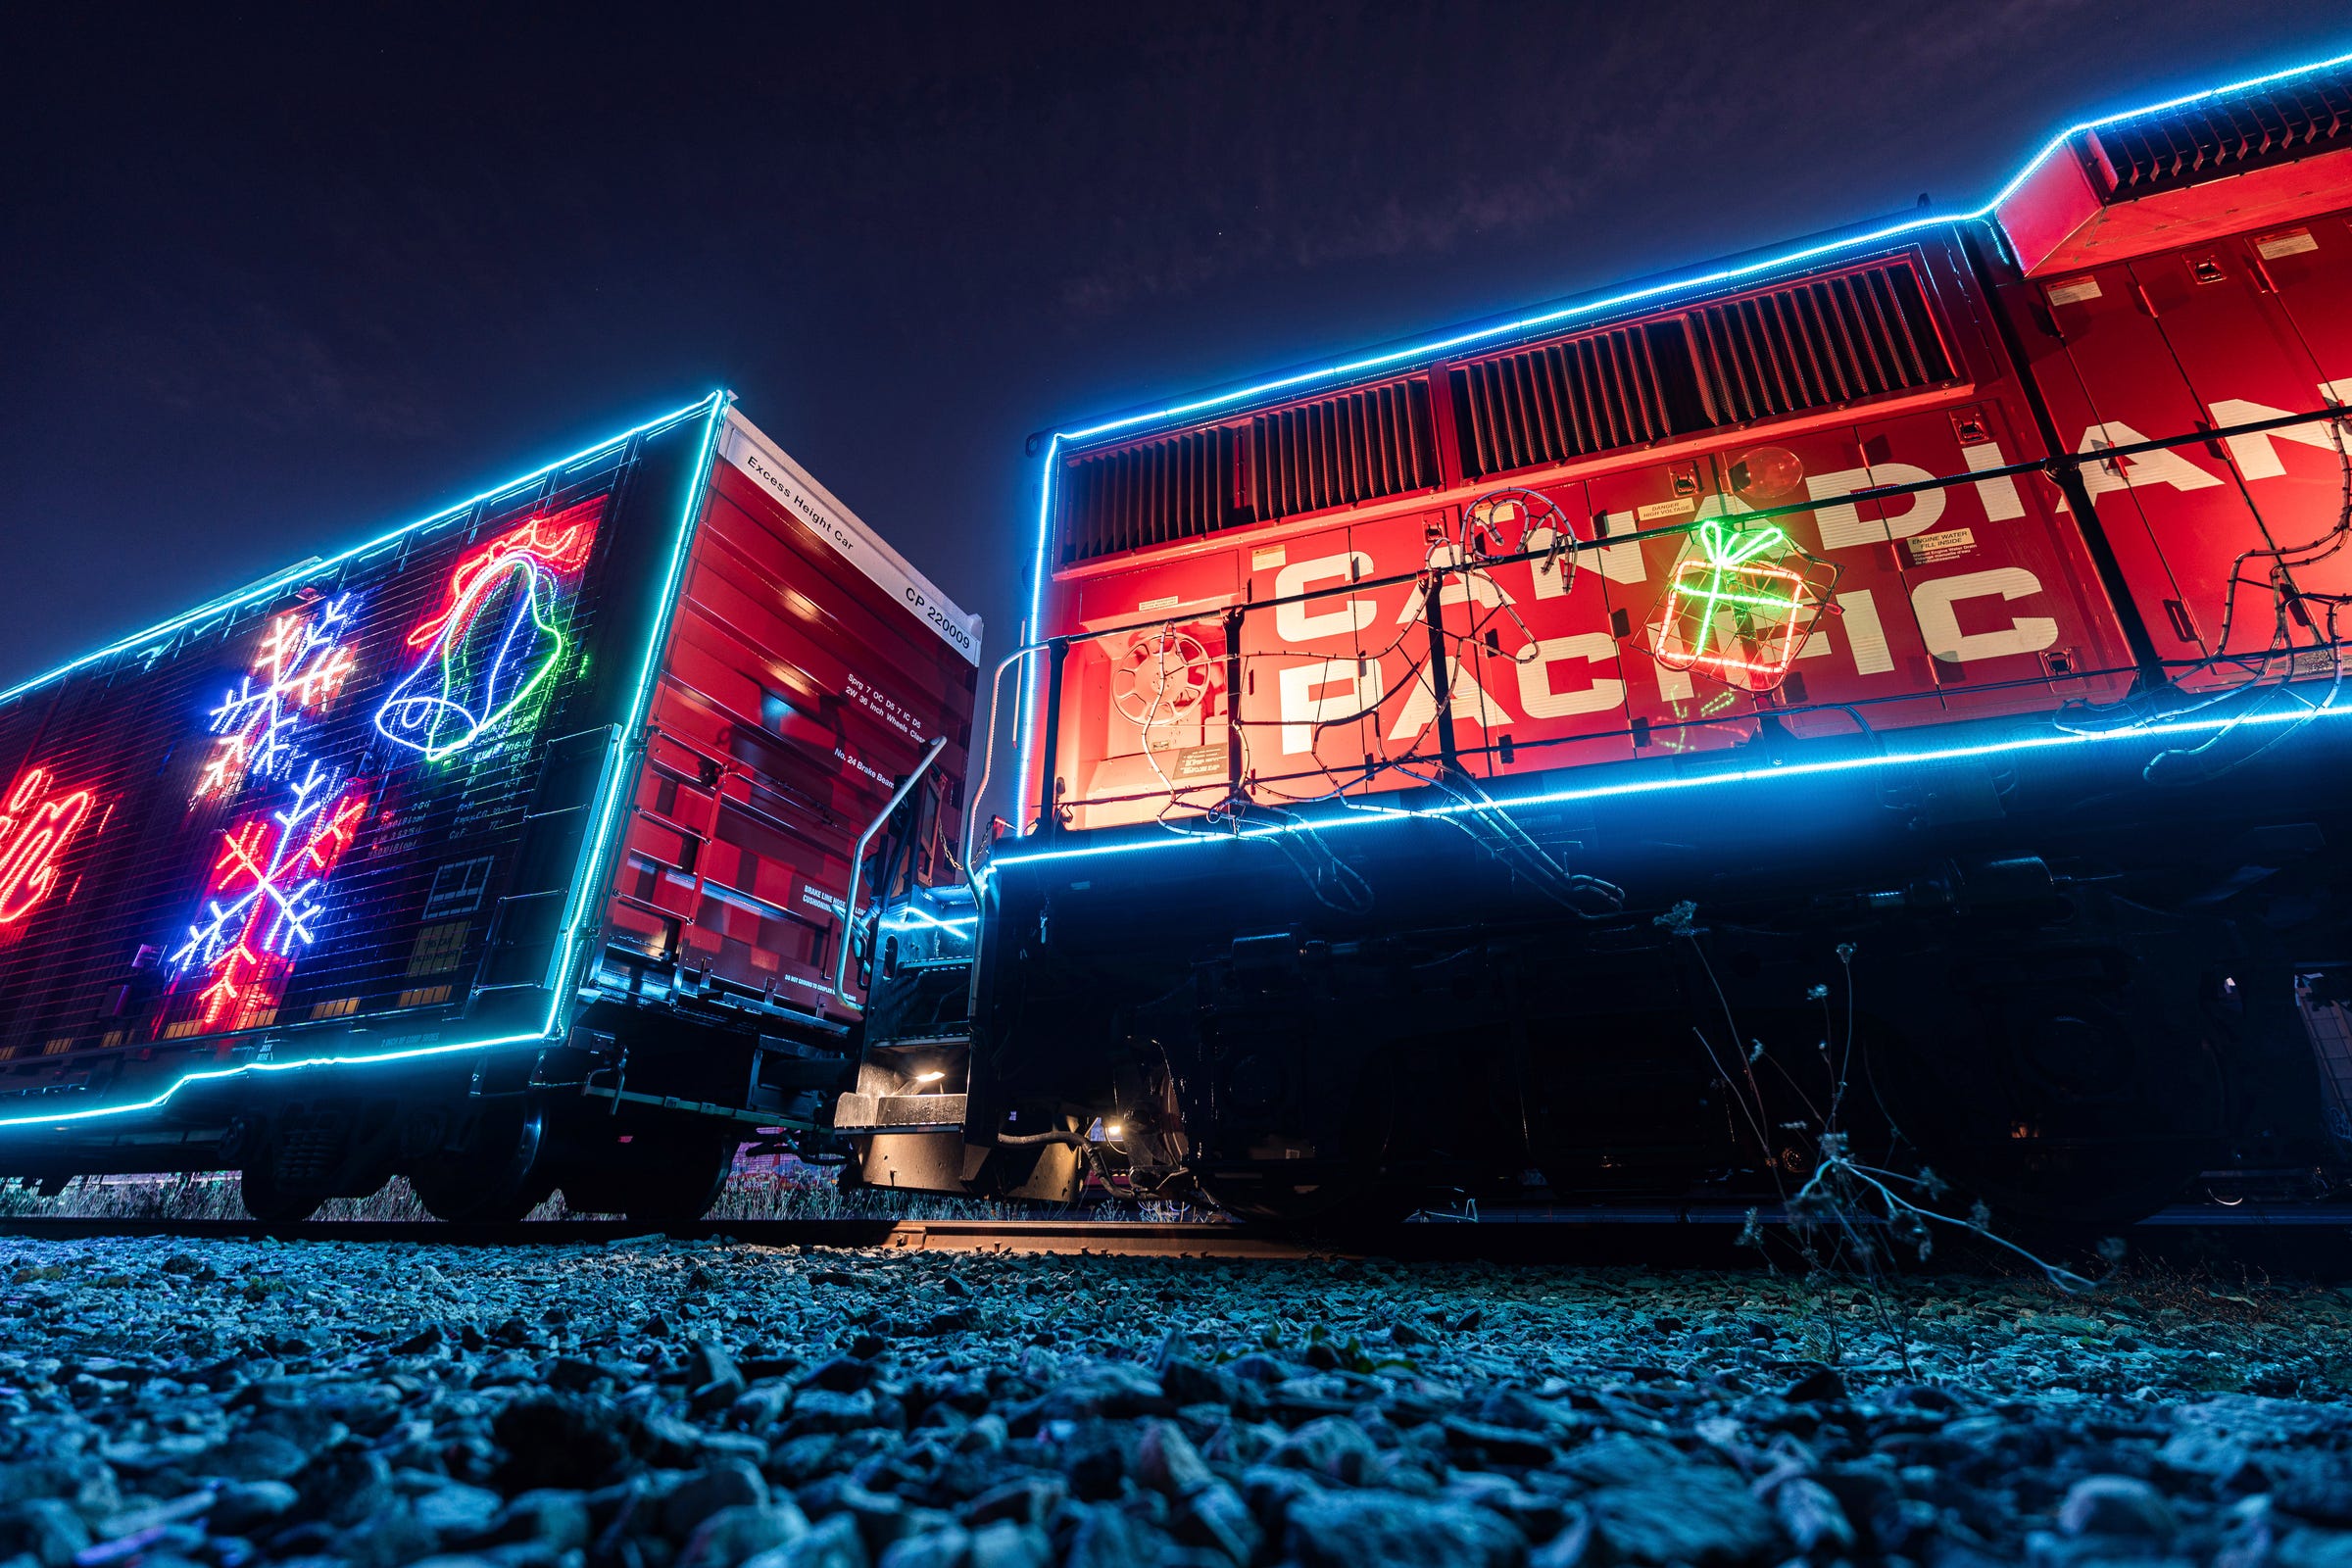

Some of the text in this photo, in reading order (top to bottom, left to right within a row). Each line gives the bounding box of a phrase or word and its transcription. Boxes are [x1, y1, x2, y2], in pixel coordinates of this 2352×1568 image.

[747, 456, 854, 550] Excess Height Car
[1652, 502, 1679, 512] DANGER
[1660, 505, 1690, 514] VOLTAGE
[1912, 530, 1968, 545] ENGINE WATER
[906, 588, 970, 649] CP 220009
[1278, 566, 2059, 756] PACIFIC
[845, 685, 858, 699] 2W
[869, 702, 884, 716] Inch
[886, 712, 908, 734] Wheels
[848, 673, 864, 691] Sprg
[885, 700, 896, 710] D5
[897, 707, 902, 715] 7
[911, 717, 921, 729] D5
[834, 747, 847, 761] No.
[847, 756, 858, 767] 24
[857, 760, 877, 778] Brake
